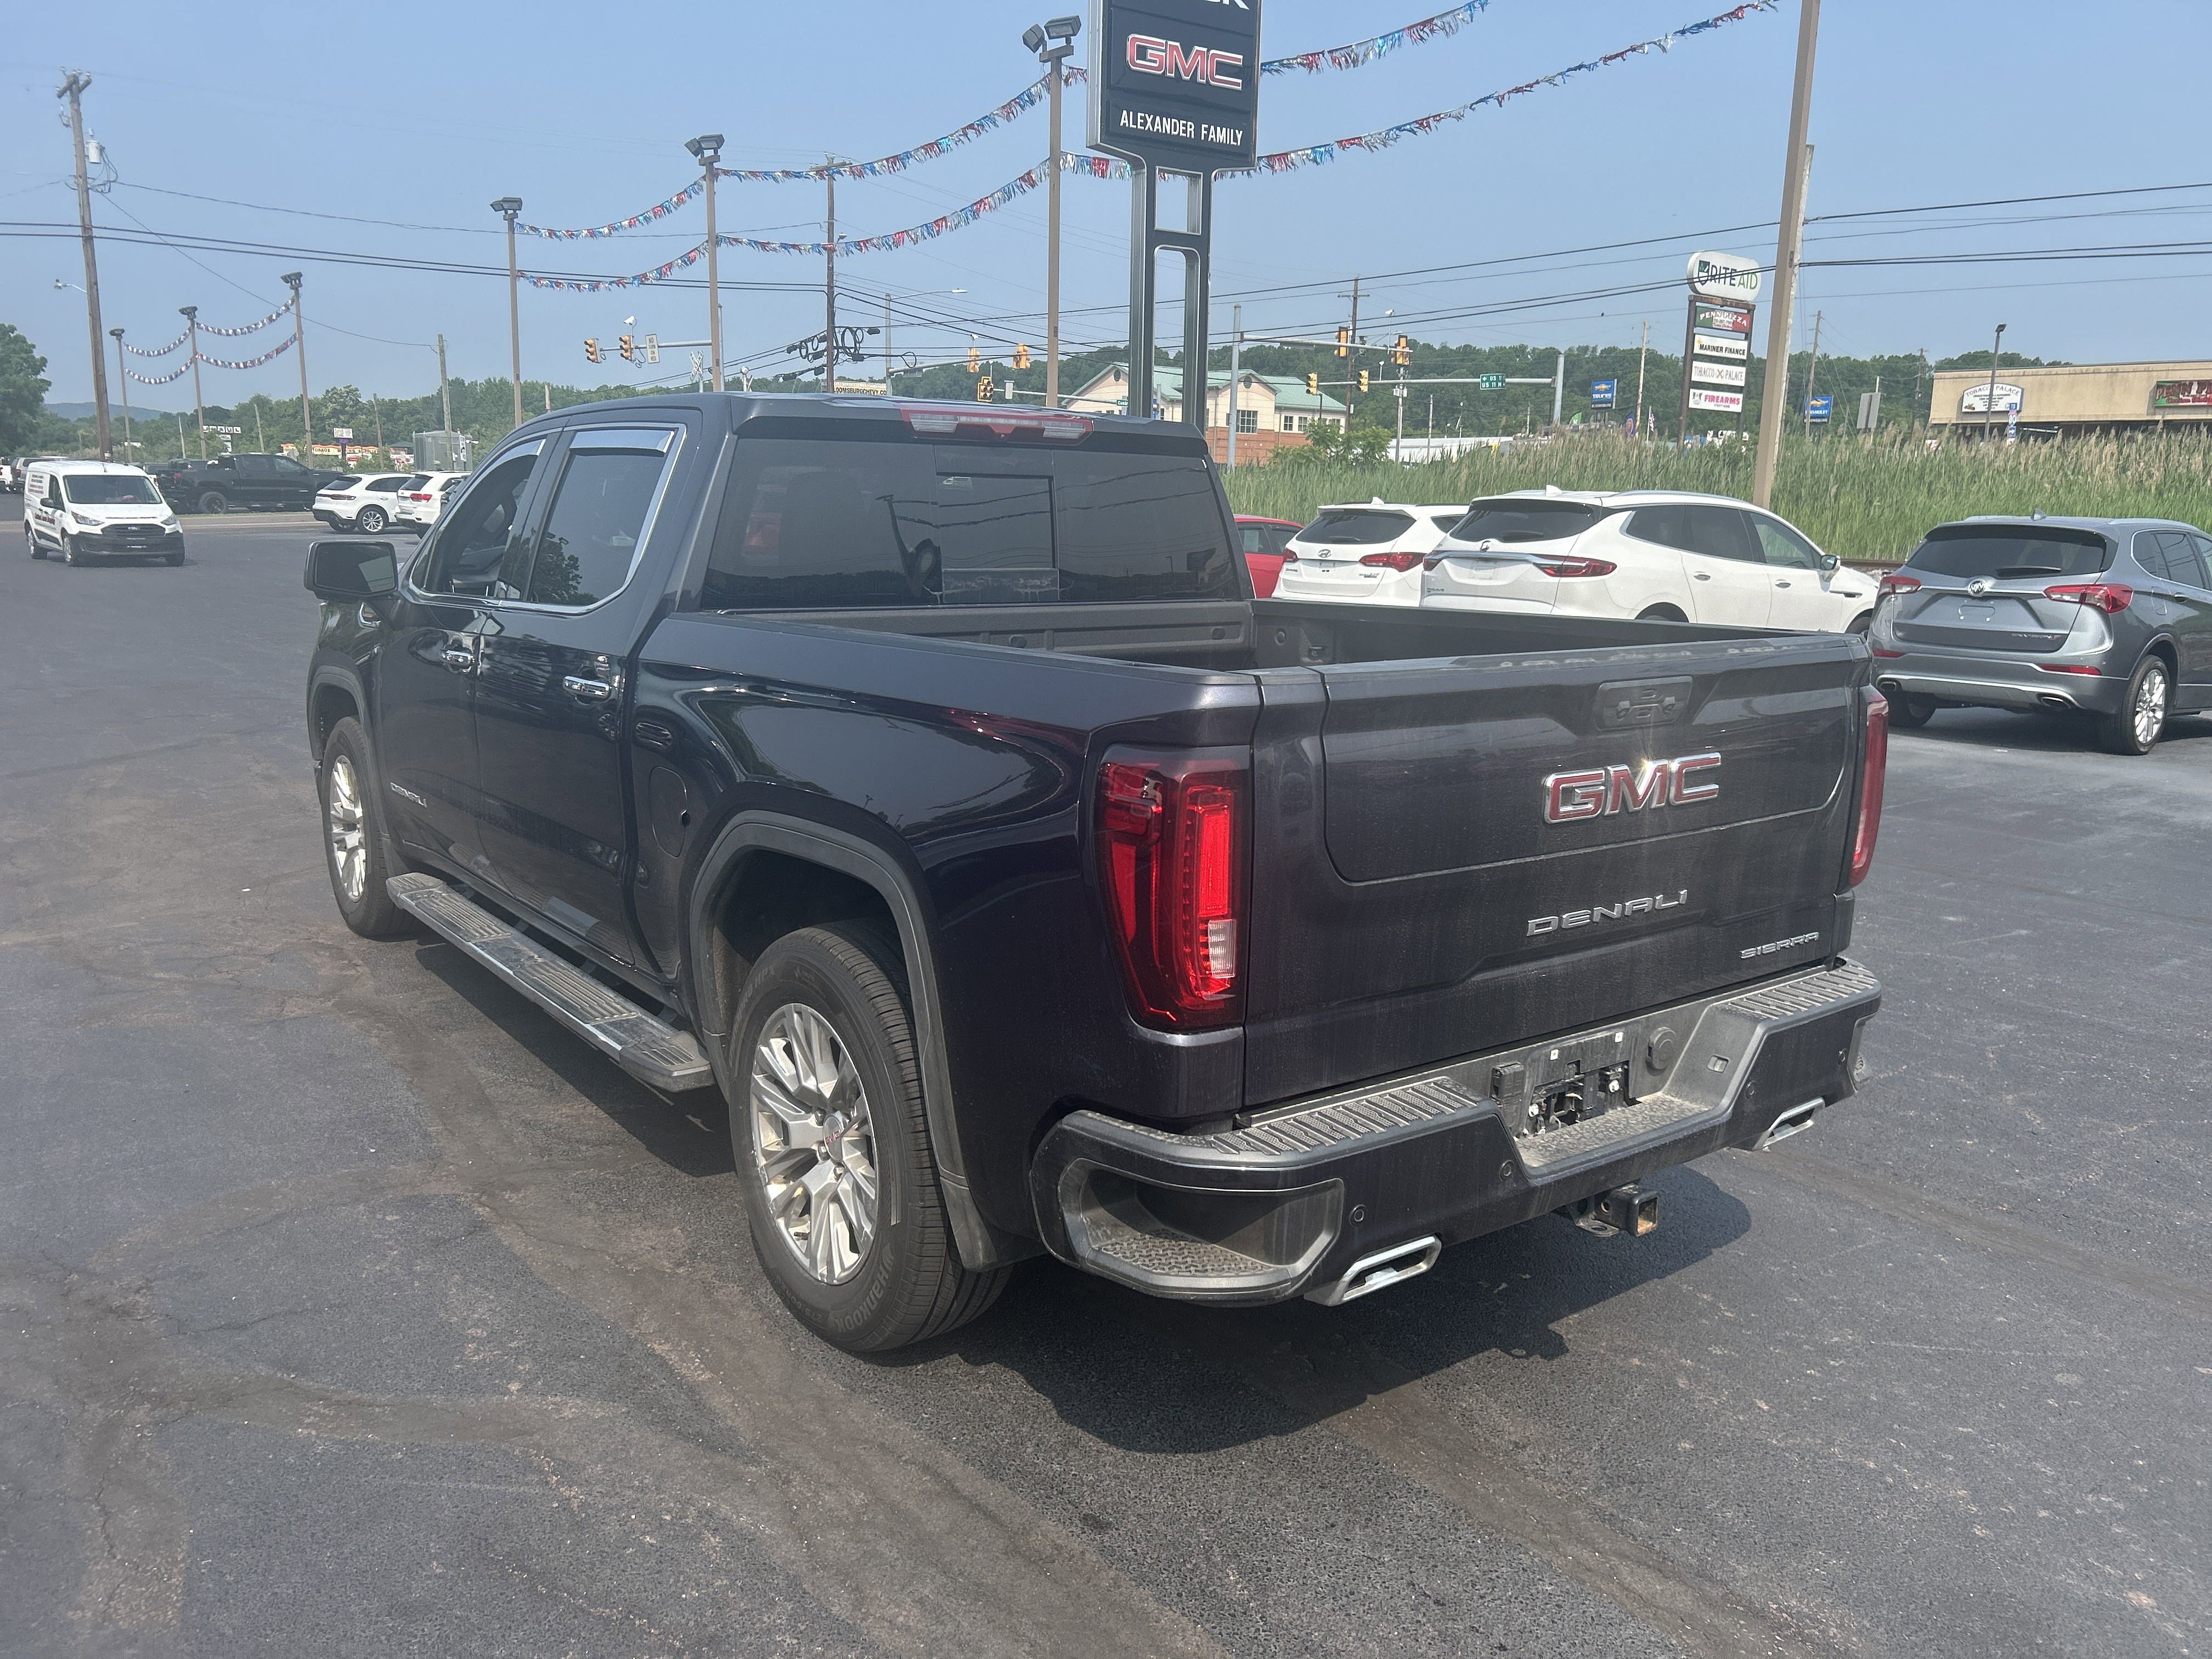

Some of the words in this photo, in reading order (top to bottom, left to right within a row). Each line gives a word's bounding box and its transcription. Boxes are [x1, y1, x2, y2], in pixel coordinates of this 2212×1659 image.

[1127, 33, 1243, 91] GMC
[1120, 110, 1195, 138] ALEXANDER
[1201, 124, 1243, 146] FAMILY
[1710, 264, 1737, 286] RITE
[1737, 271, 1758, 290] AID
[1700, 311, 1722, 320] PENN
[1724, 312, 1747, 326] PIZZA
[1699, 343, 1723, 353] MARINER
[1724, 347, 1746, 356] FINANCE
[1694, 366, 1715, 377] TOBACCO
[1725, 369, 1743, 381] PALACE
[1704, 394, 1740, 405] FIREARMS
[1966, 386, 1990, 397] TOBACC
[1995, 386, 2020, 396] PALACE
[2010, 414, 2016, 424] 80
[1543, 752, 1722, 823] GMC
[1527, 889, 1688, 936] DENALI
[1740, 932, 1819, 960] SIERRA
